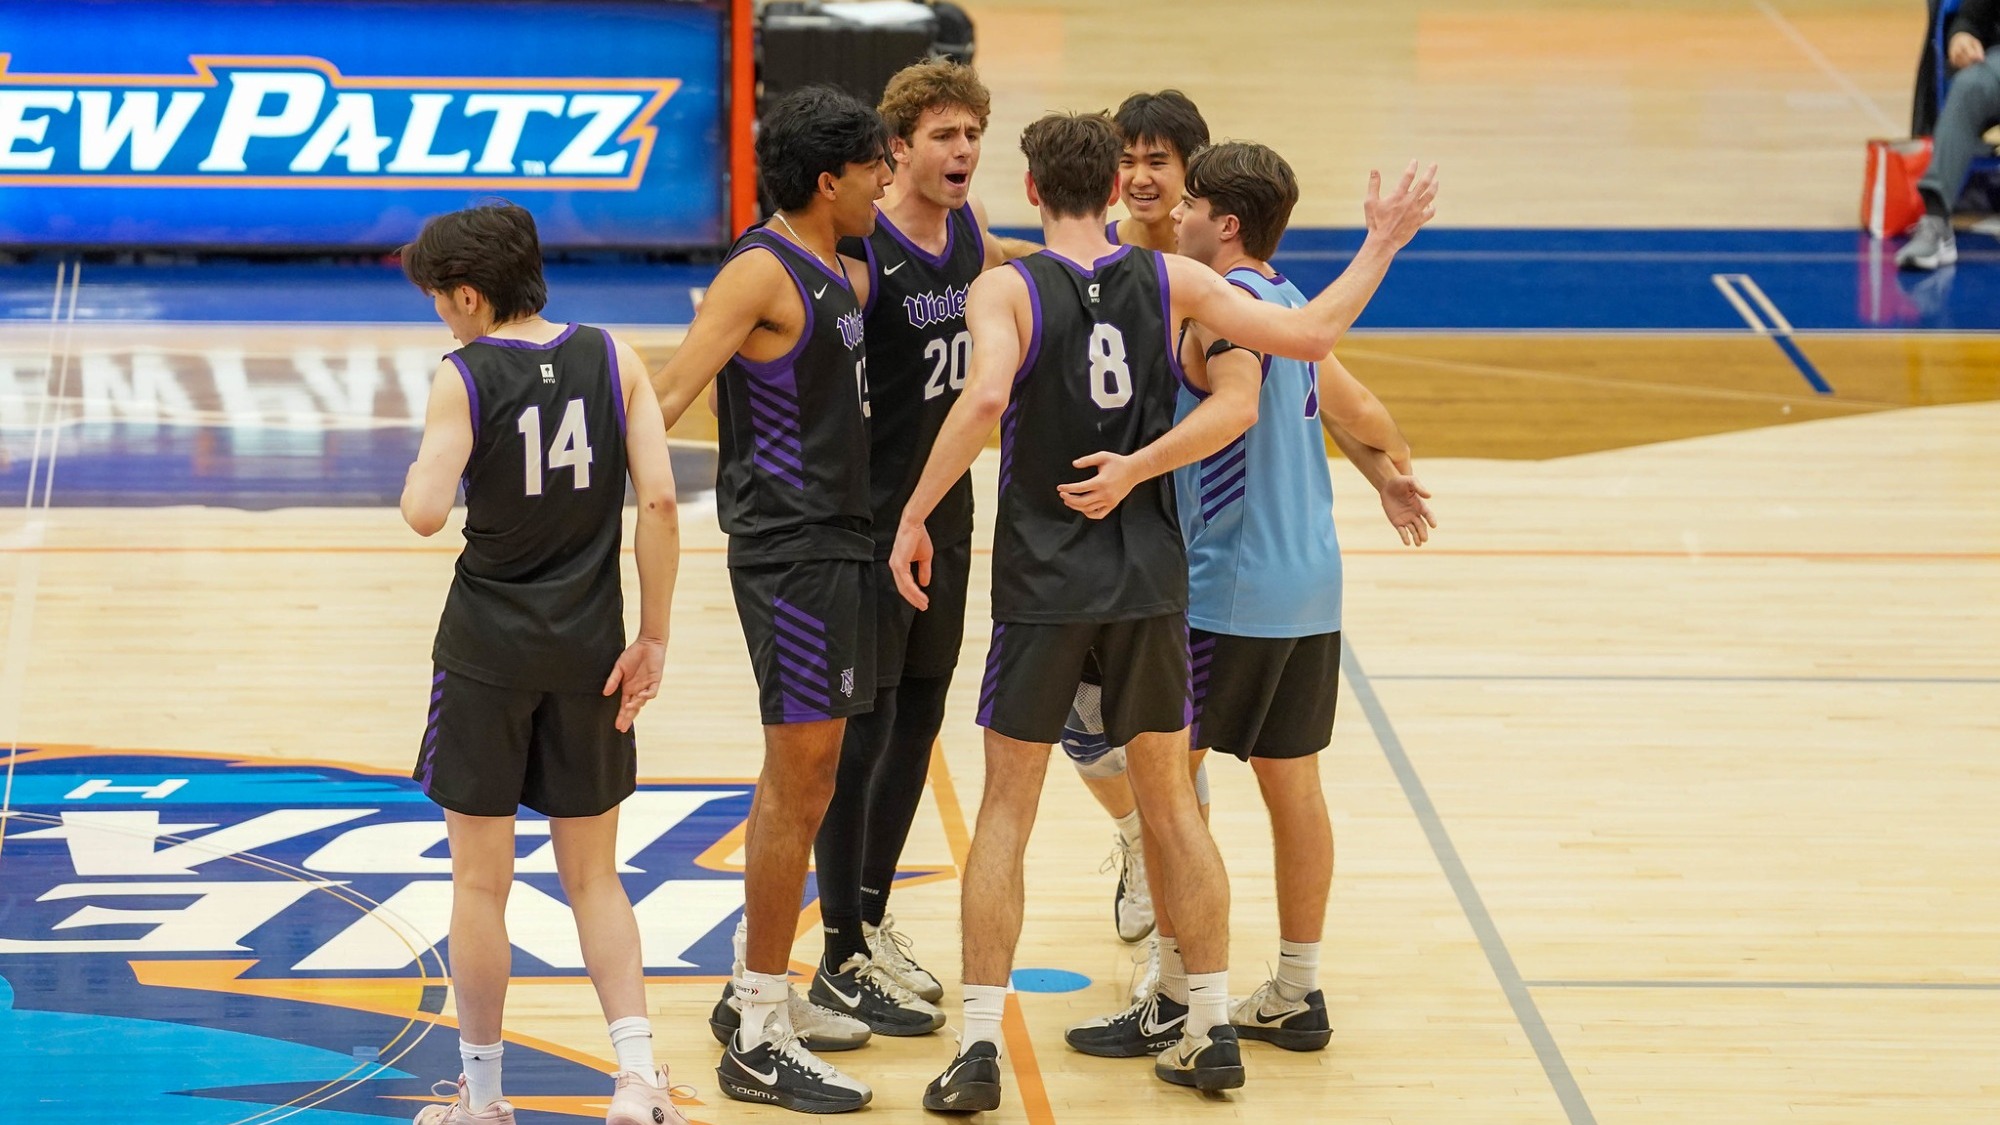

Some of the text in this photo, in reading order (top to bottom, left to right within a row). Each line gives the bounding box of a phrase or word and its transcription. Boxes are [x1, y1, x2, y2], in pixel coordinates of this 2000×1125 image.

[924, 330, 973, 401] 20
[1088, 322, 1133, 409] 8
[518, 398, 593, 496] 14
